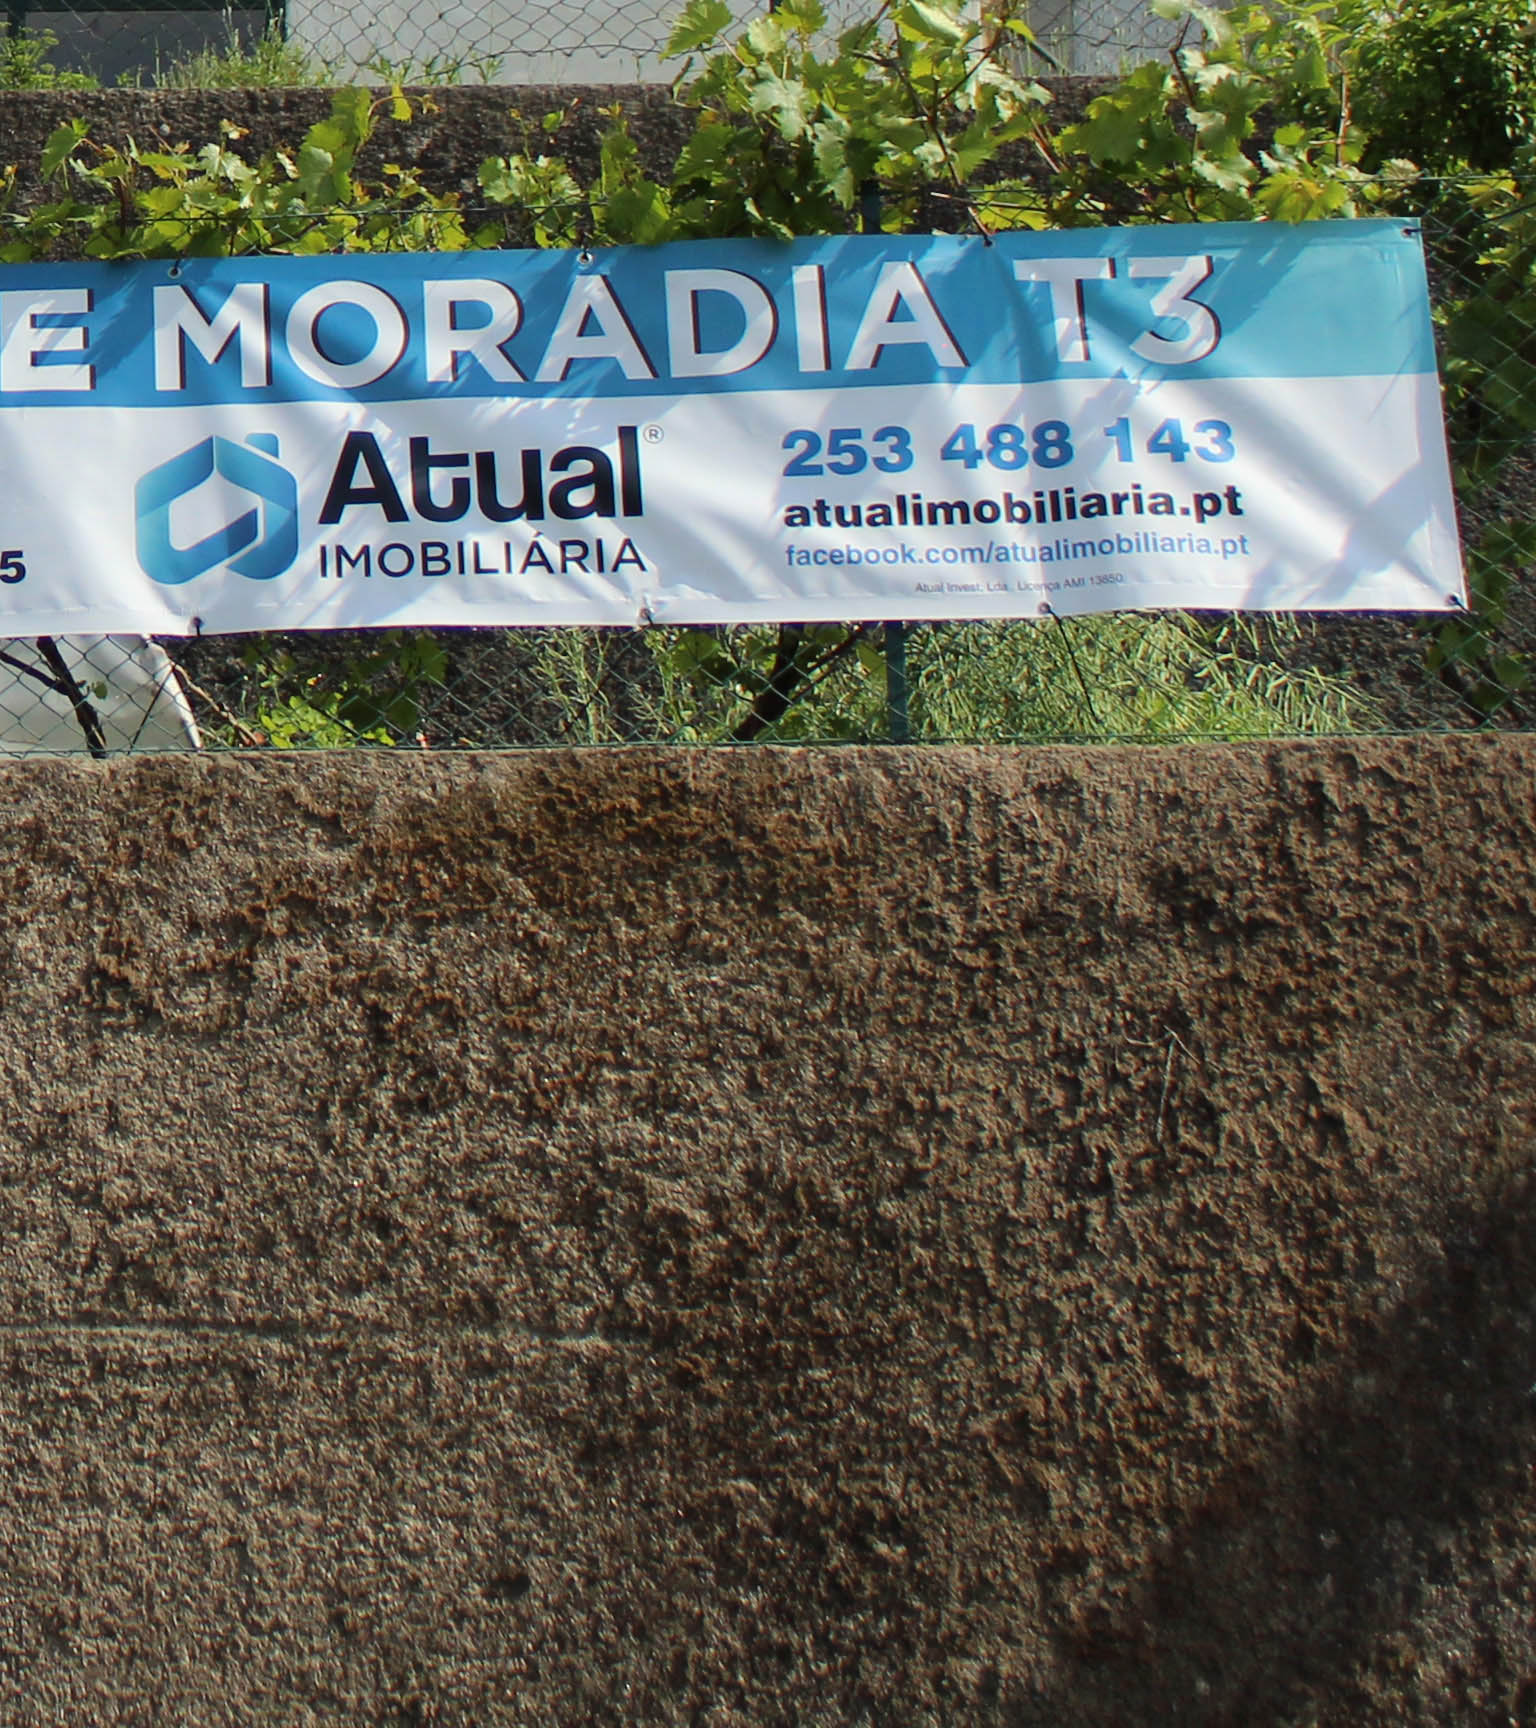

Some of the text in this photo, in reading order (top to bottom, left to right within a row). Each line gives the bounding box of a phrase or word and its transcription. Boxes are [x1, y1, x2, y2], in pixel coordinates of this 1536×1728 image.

[153, 259, 970, 393] MORADIA
[1013, 254, 1220, 365] T3
[782, 417, 1235, 477] 253 488 143
[318, 425, 644, 525] Atual
[783, 484, 1244, 529] atualimobiliaria.pt
[319, 530, 648, 578] IMOBILIÁRIA
[785, 531, 1250, 567] facebook.com/atualimobiliaria.pt
[1062, 577, 1086, 590] AMI
